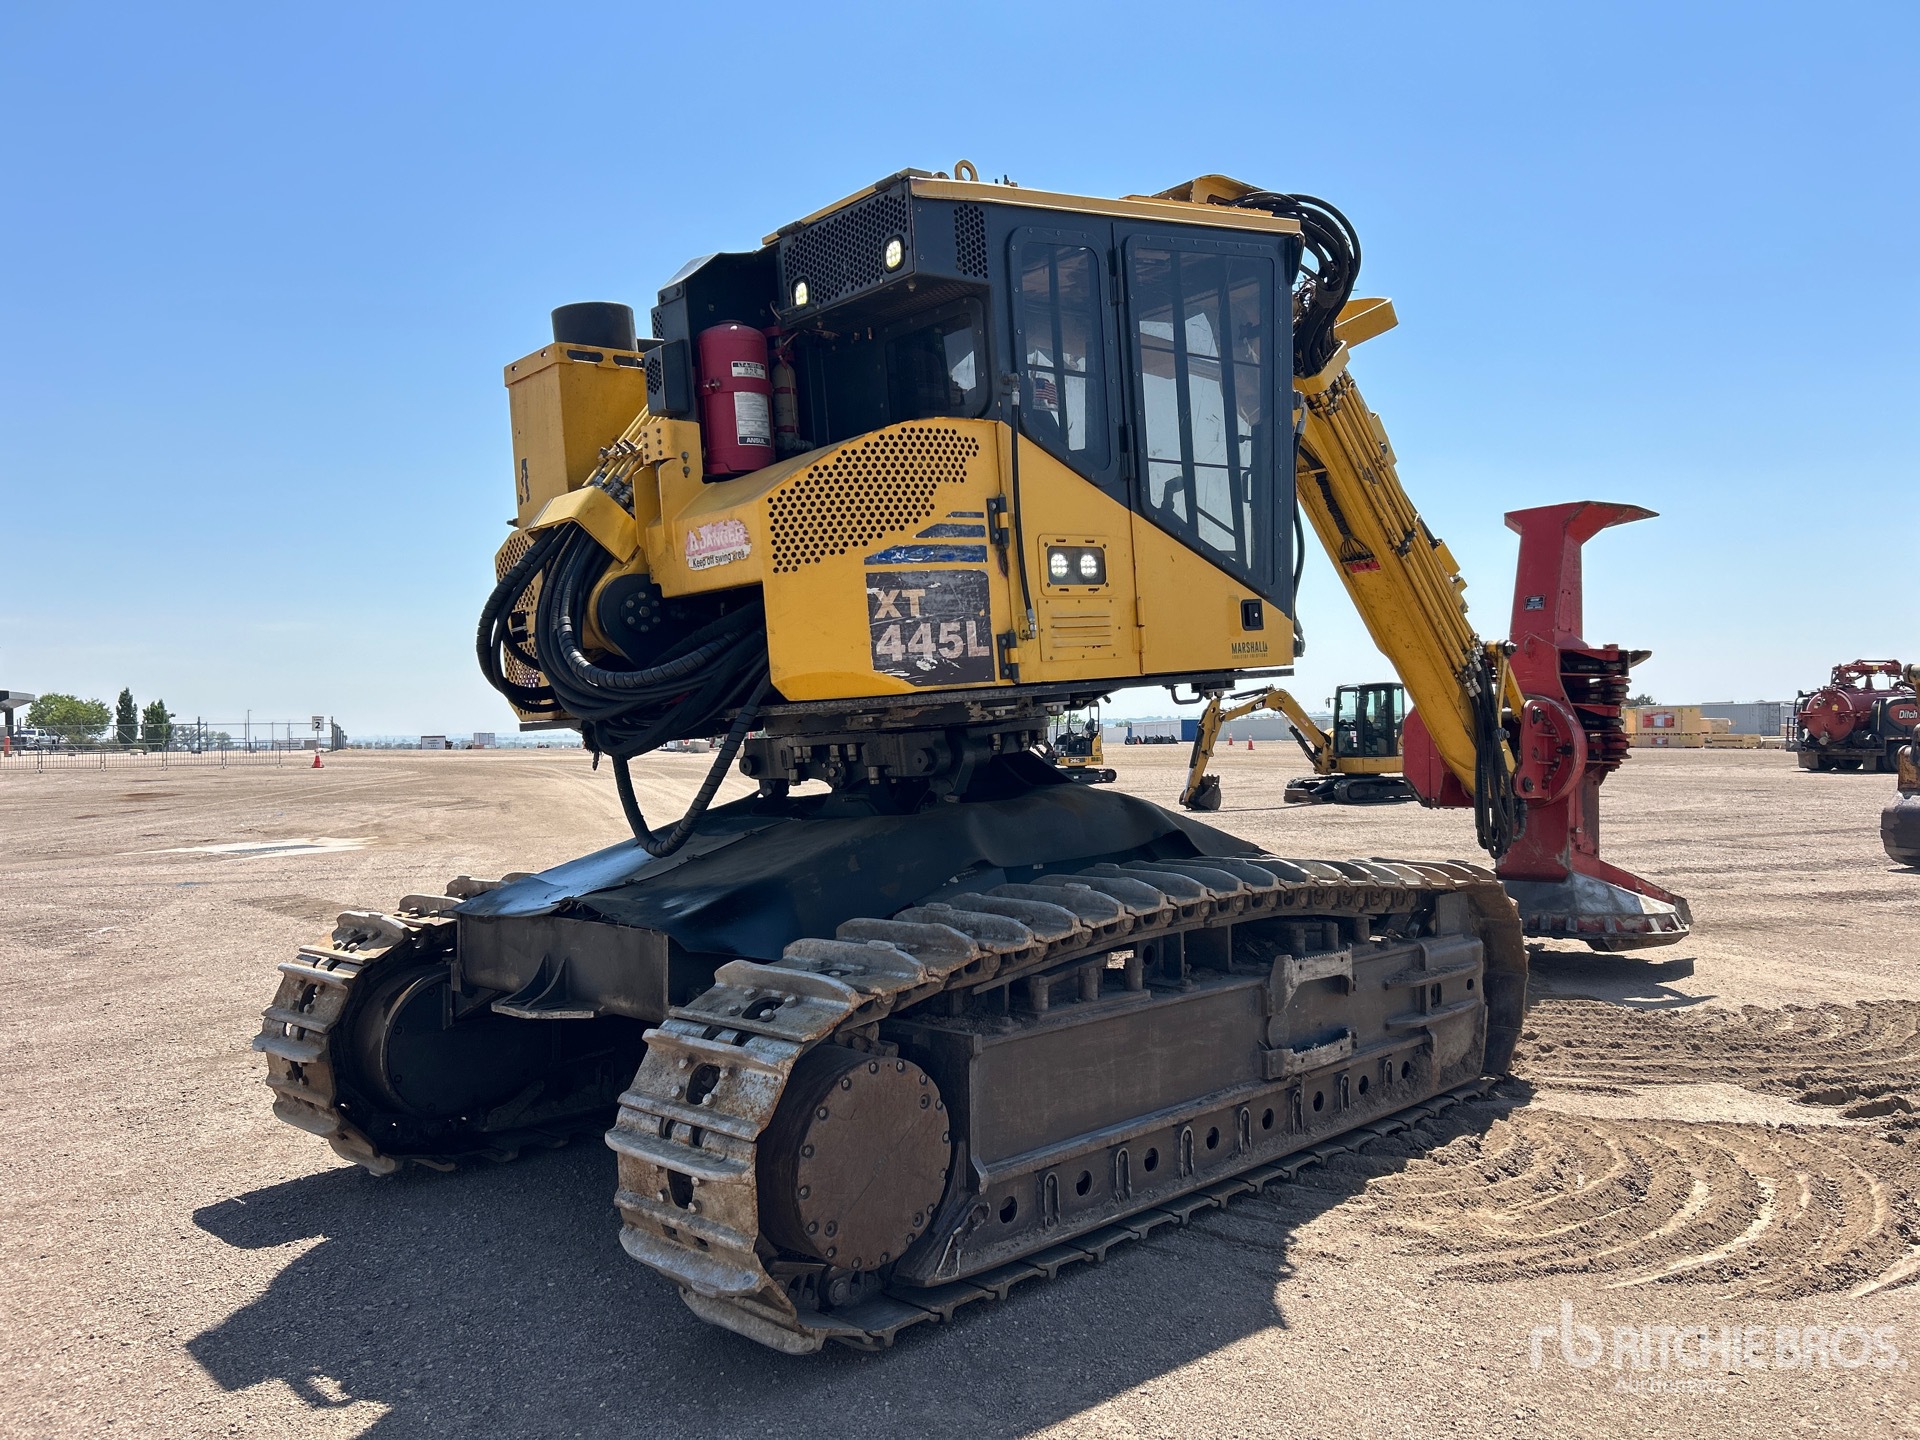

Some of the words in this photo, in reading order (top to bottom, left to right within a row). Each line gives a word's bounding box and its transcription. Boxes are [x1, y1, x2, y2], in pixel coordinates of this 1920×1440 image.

[746, 437, 766, 445] ANSUL
[692, 557, 706, 569] Keep
[707, 554, 715, 565] off
[715, 551, 732, 564] swing
[732, 549, 745, 561] area
[874, 588, 926, 619] XT
[875, 620, 990, 662] 445L
[1231, 640, 1268, 654] MARSHALL
[1898, 710, 1918, 719] Ditch
